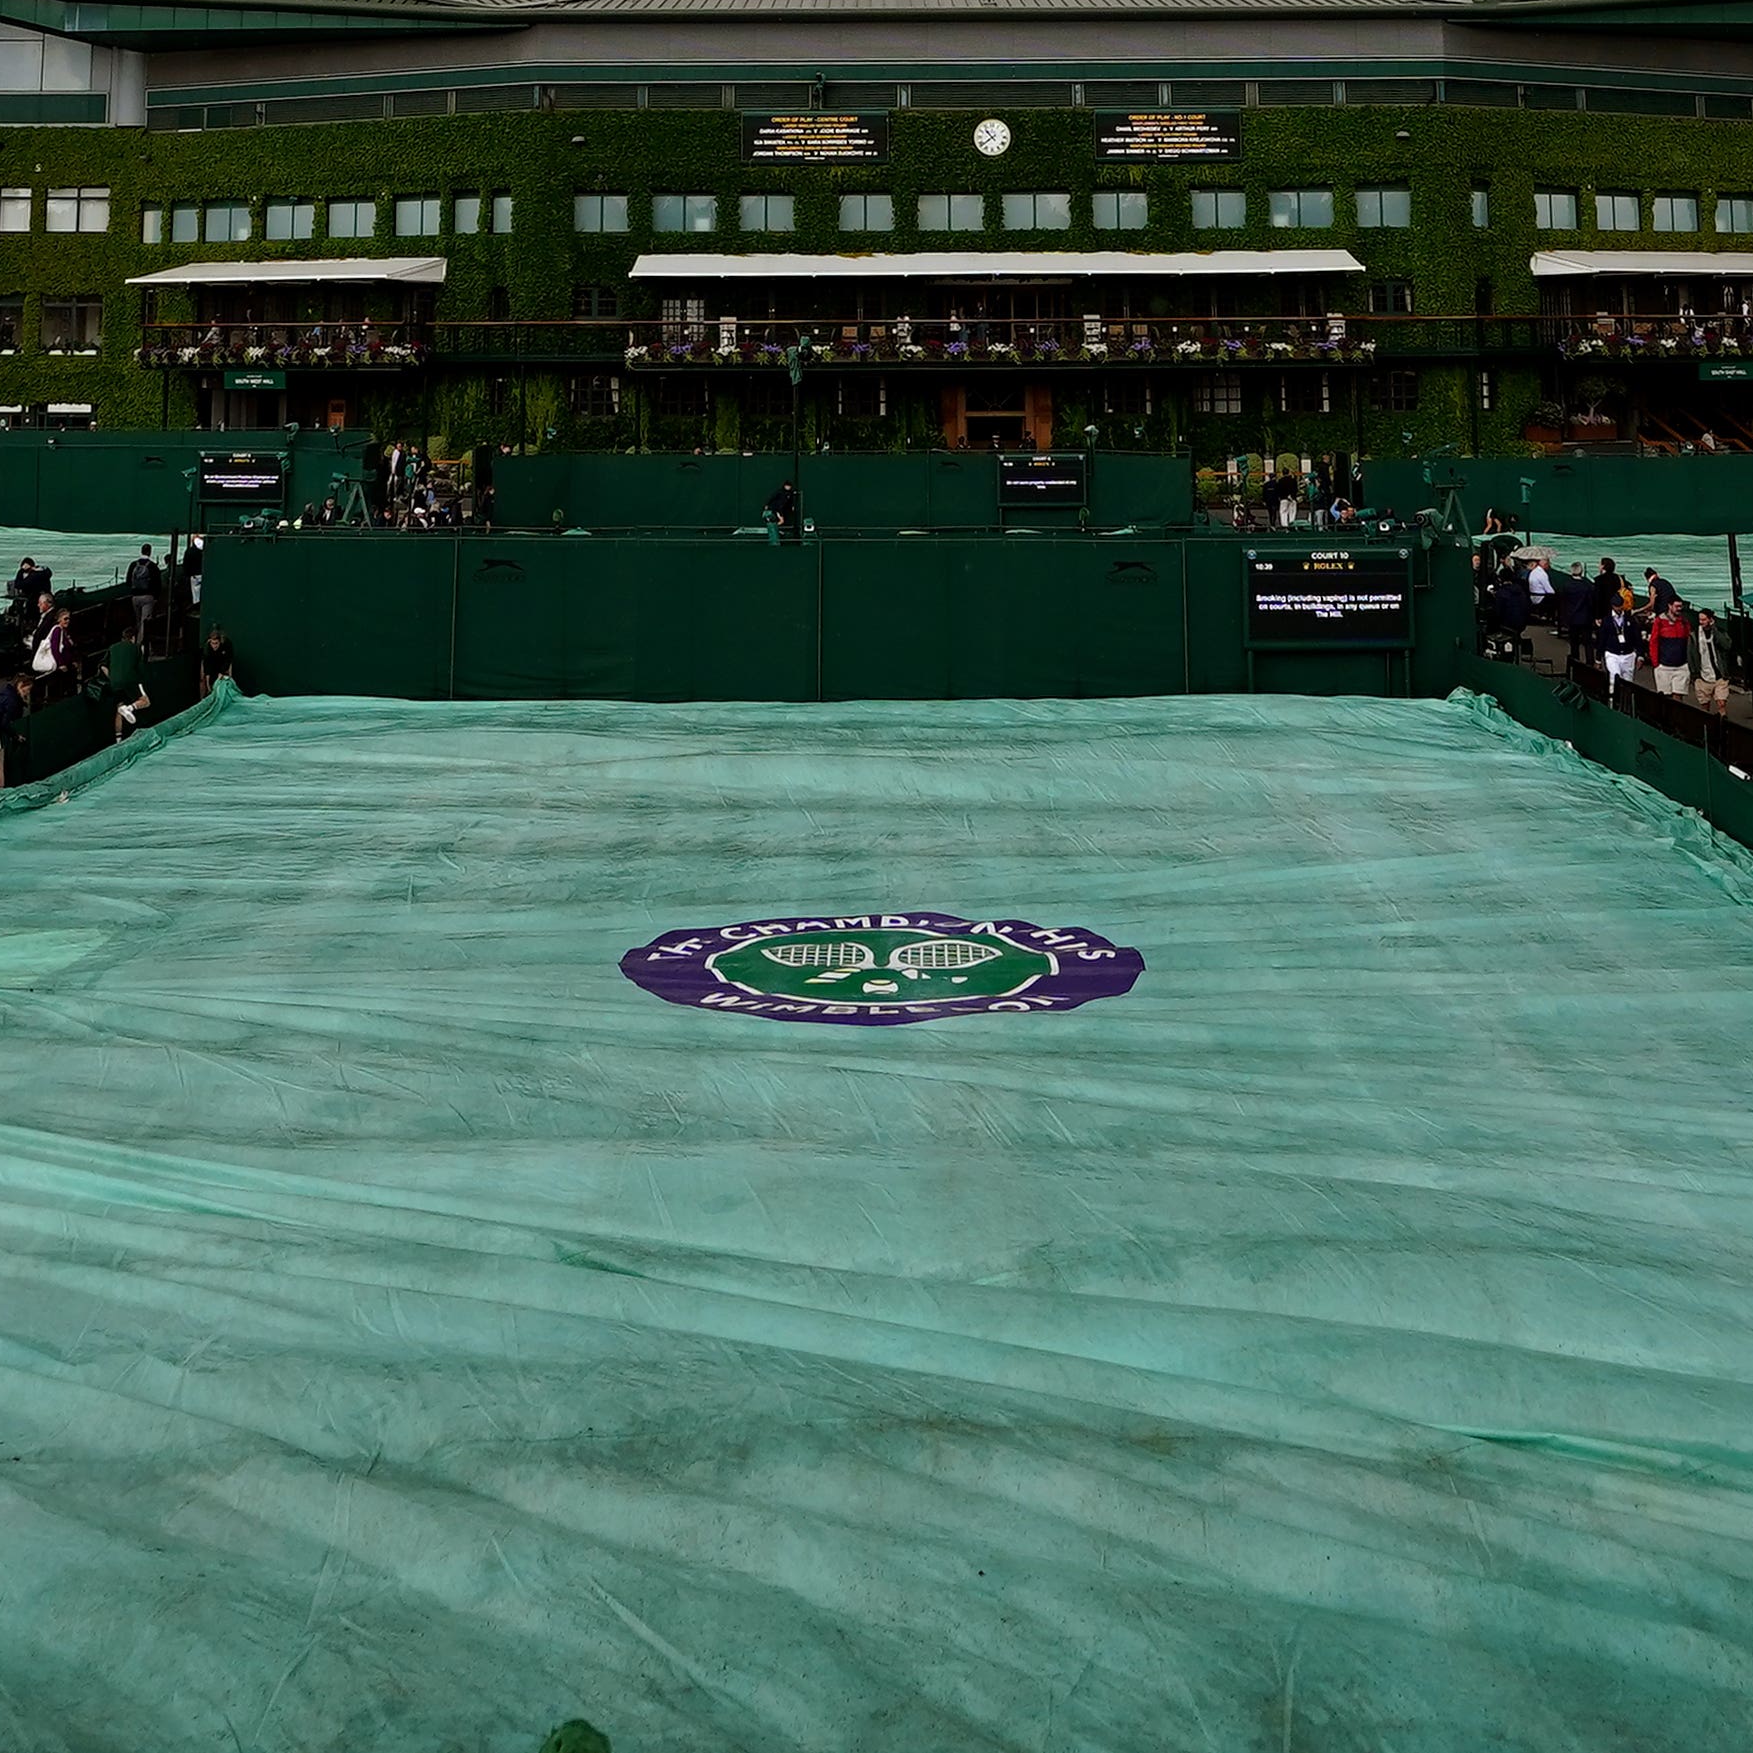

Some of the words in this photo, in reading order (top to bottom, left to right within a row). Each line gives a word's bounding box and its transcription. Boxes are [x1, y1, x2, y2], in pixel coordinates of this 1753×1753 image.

[1313, 562, 1343, 570] ROLEX
[1256, 594, 1286, 602] Smoking
[1287, 594, 1322, 602] (including
[1322, 594, 1348, 602] vaping)
[1349, 594, 1355, 602] is
[1356, 594, 1368, 602] not
[1369, 594, 1402, 602] permitted
[1345, 603, 1357, 611] any
[1358, 603, 1380, 611] queue
[1315, 610, 1328, 618] The
